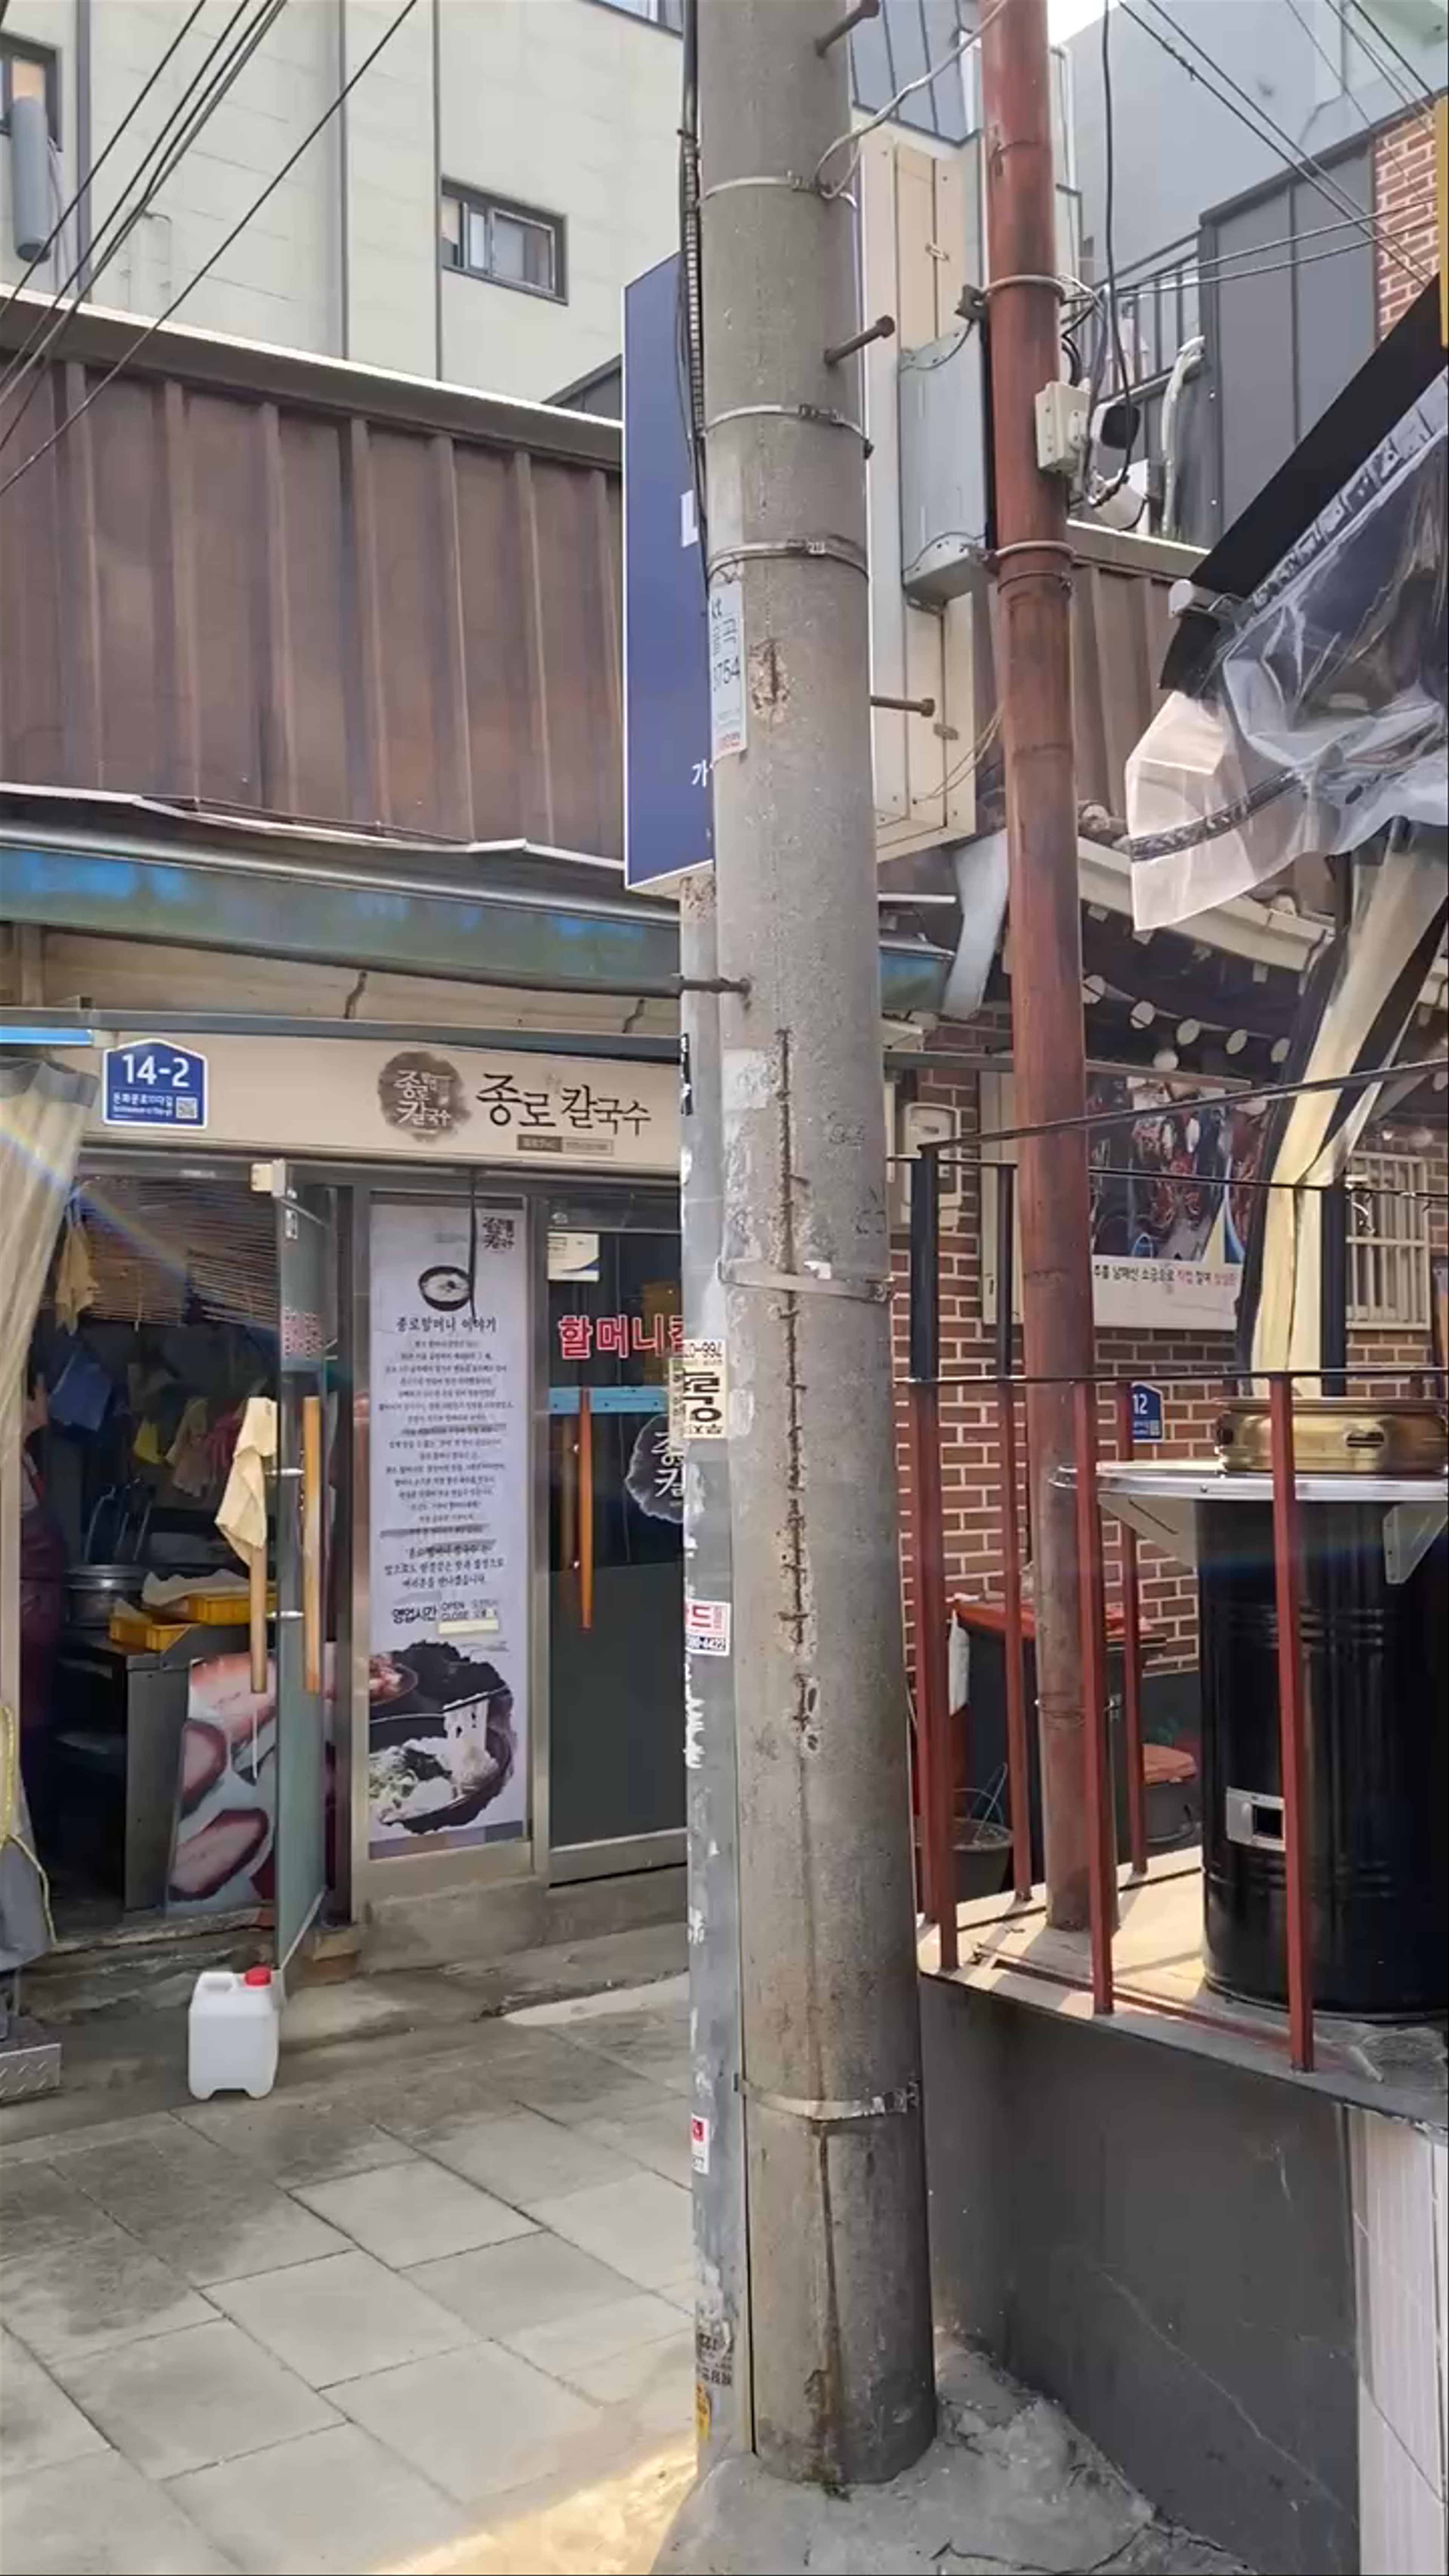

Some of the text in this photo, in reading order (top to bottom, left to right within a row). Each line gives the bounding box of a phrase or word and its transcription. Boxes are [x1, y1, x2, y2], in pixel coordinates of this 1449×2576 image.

[122, 1053, 189, 1086] 14-2
[476, 1073, 651, 1137] 종로 칼국수
